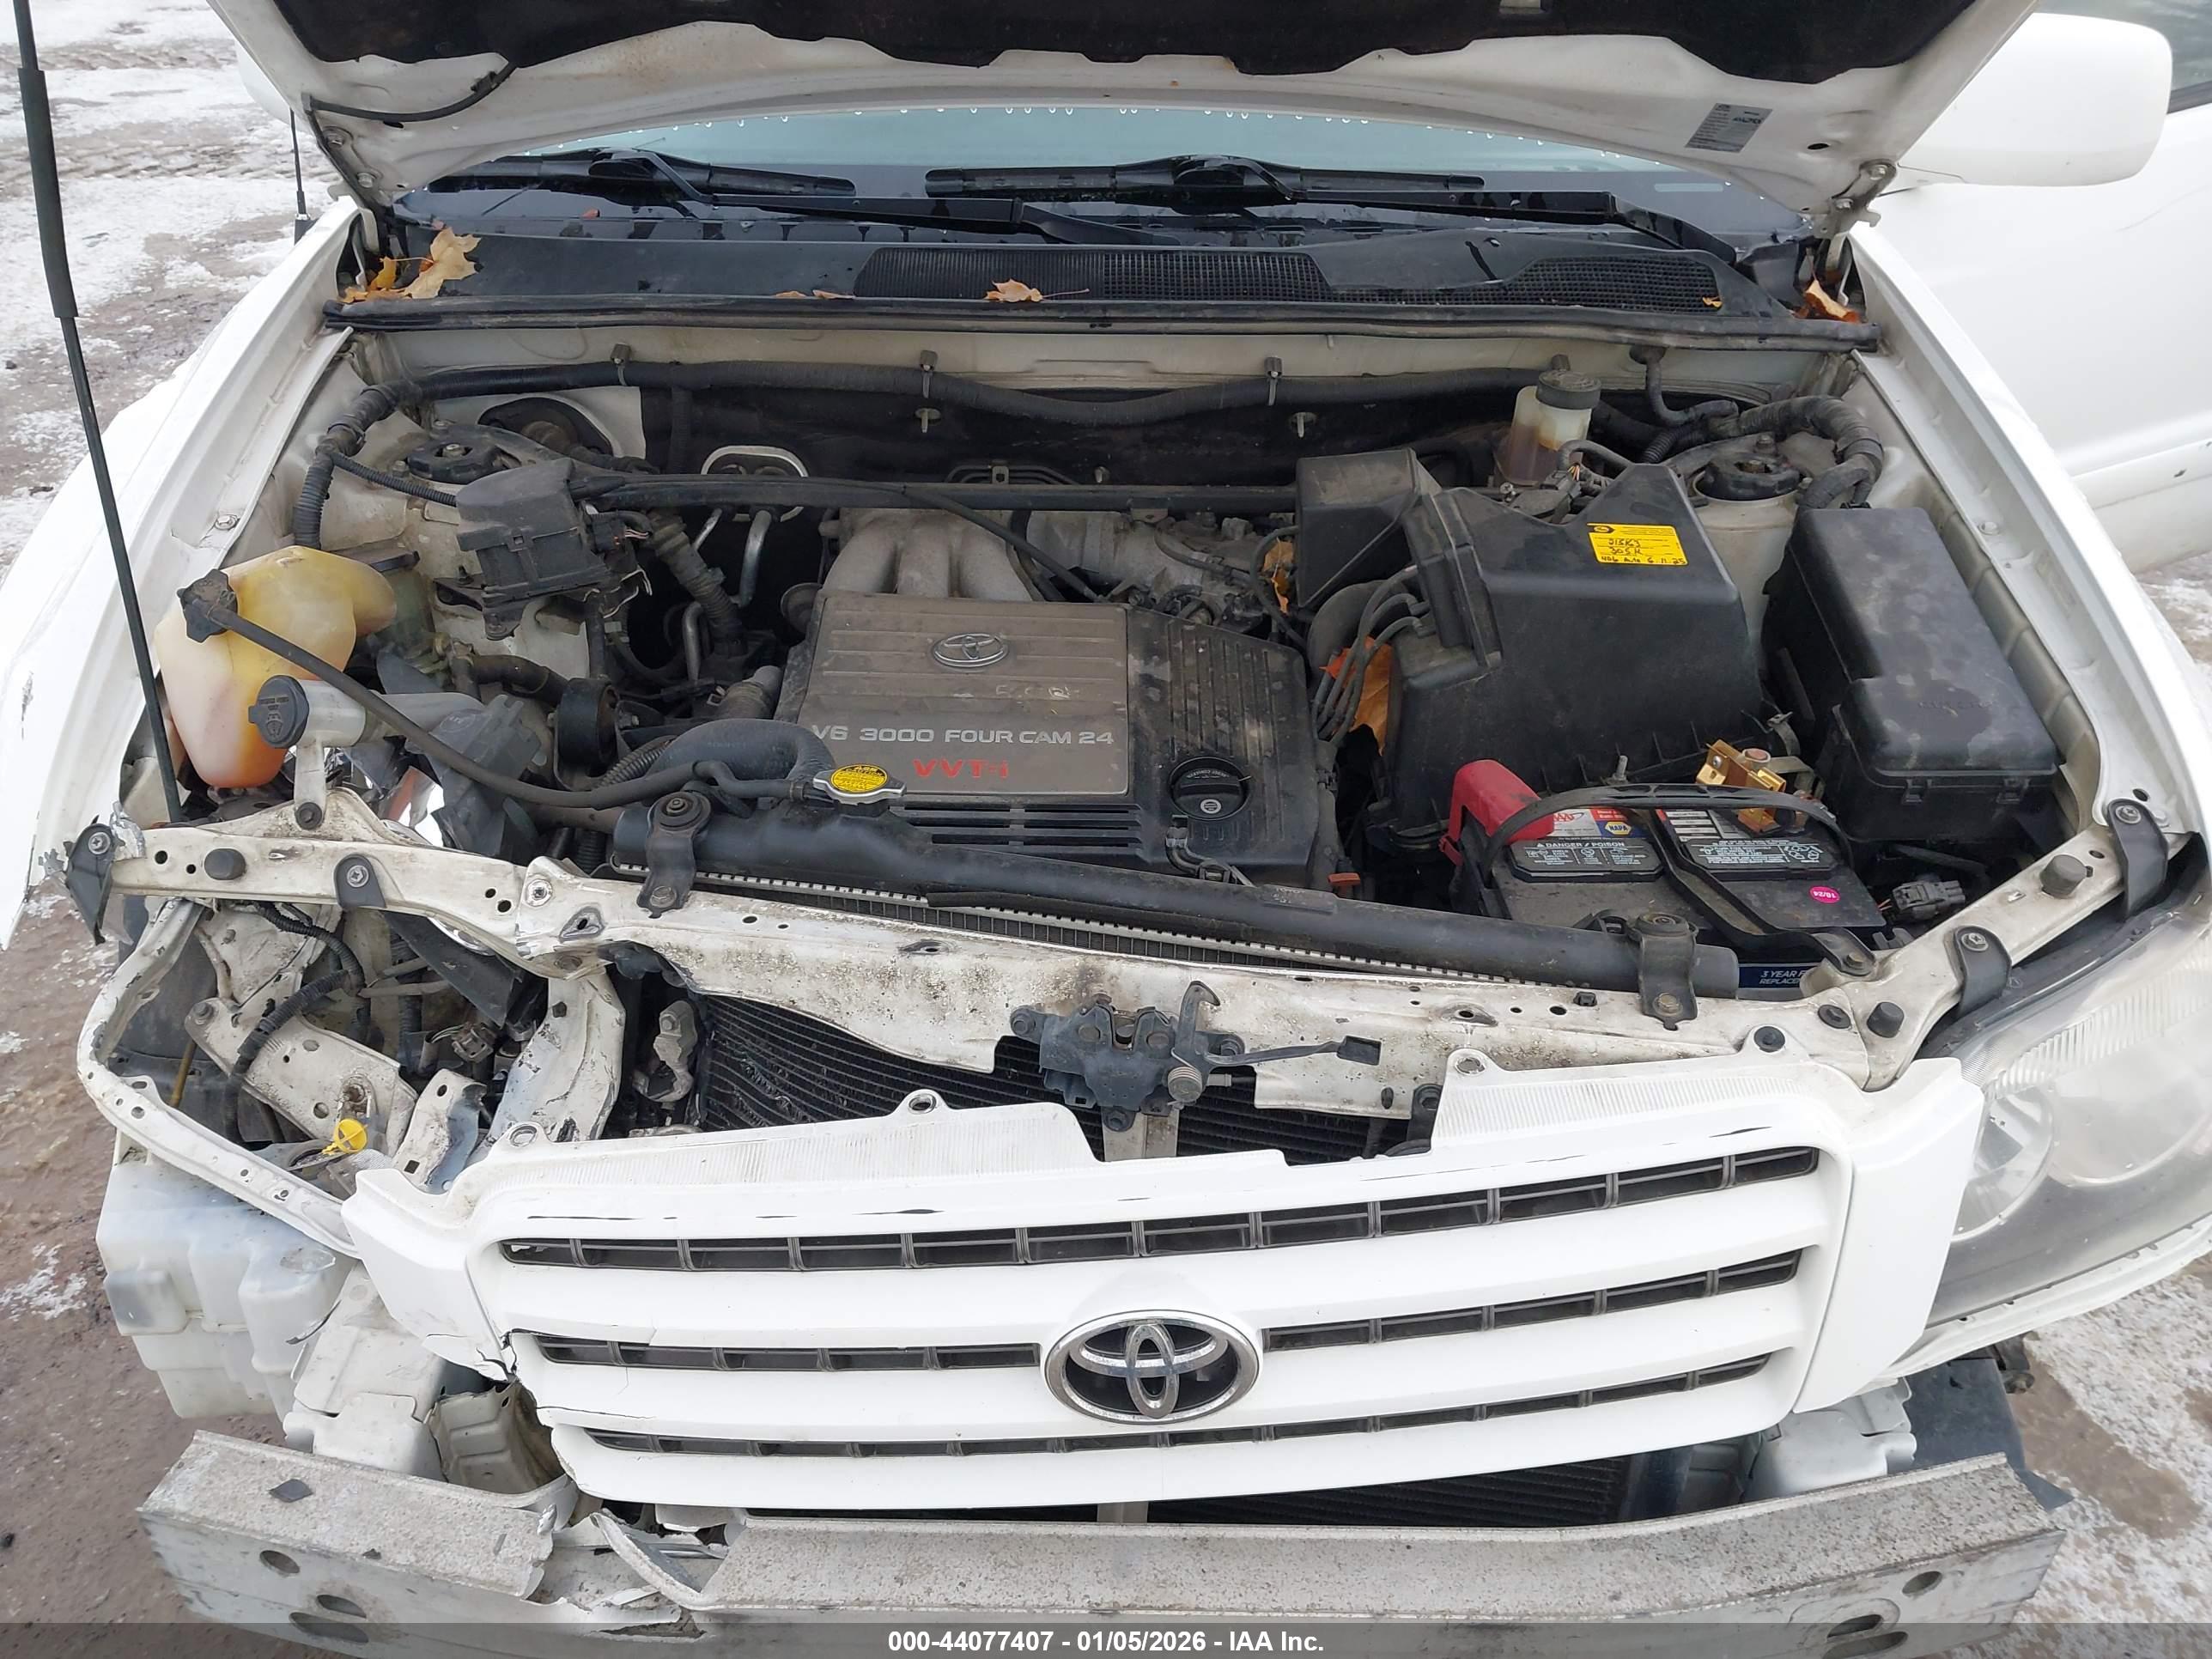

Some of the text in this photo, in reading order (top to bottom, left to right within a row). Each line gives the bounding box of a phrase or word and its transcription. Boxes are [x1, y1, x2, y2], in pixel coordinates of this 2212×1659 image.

[811, 725, 1115, 745] V6 3000 FOUR CAM 24
[913, 759, 1010, 779] VVT-i
